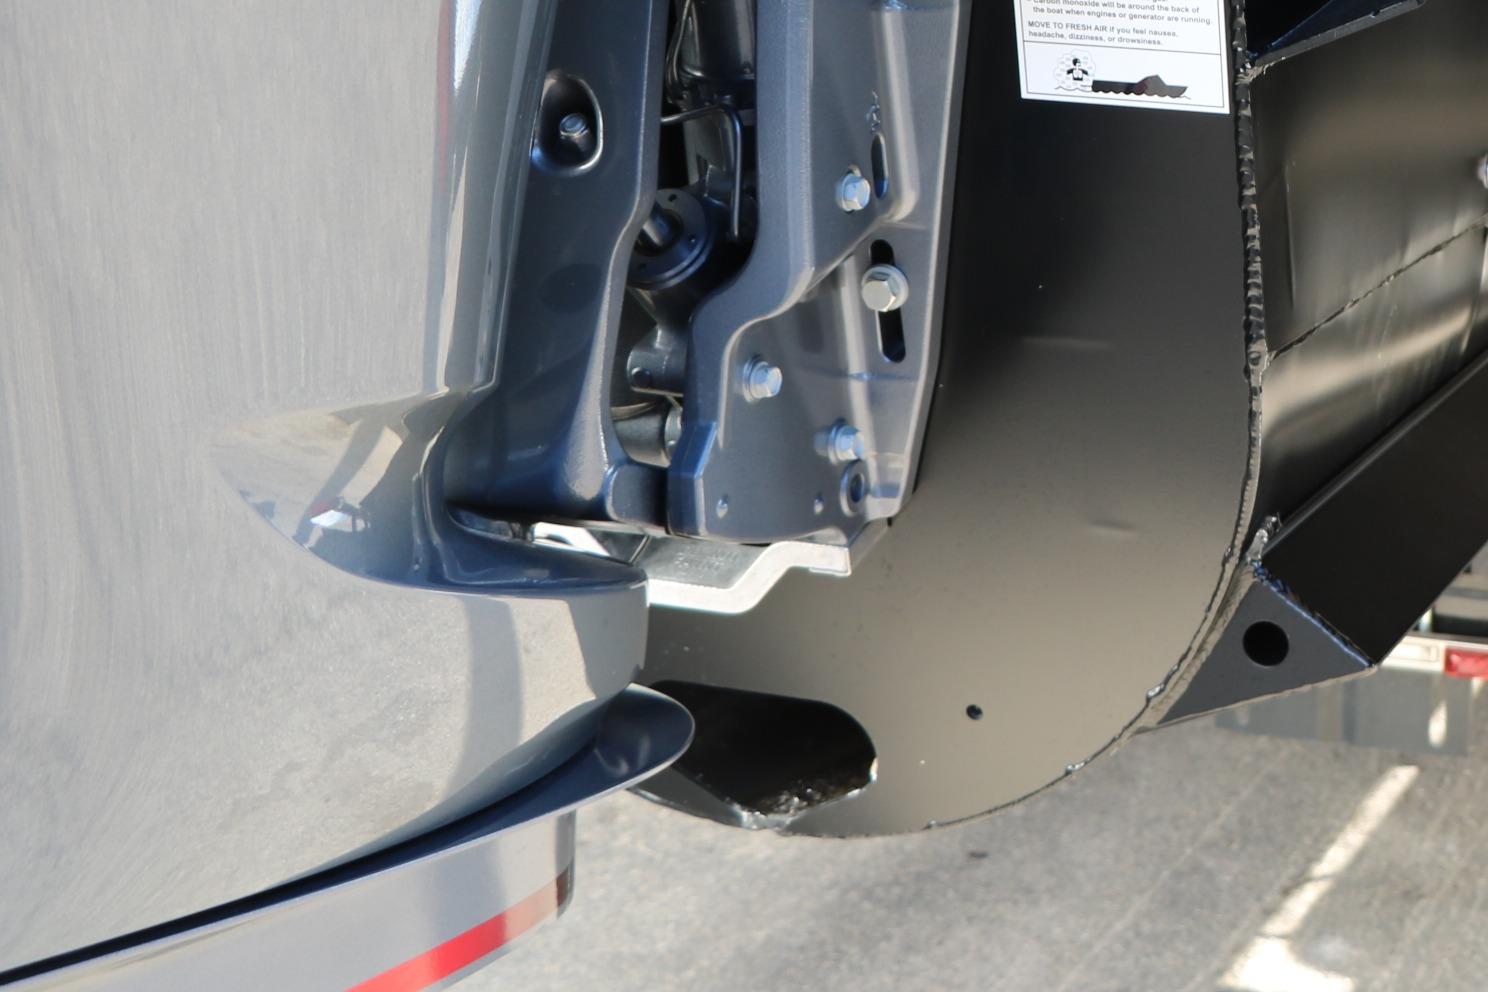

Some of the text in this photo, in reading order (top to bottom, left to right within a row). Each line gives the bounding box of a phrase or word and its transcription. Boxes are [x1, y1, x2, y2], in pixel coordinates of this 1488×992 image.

[1062, 0, 1100, 7] monoxide
[1128, 3, 1155, 11] around
[1171, 5, 1189, 13] back
[1065, 8, 1085, 16] when
[1087, 10, 1116, 18] engines
[1128, 13, 1164, 21] generator
[1028, 20, 1050, 29] MOVE
[1065, 22, 1092, 31] FRESH
[1094, 24, 1107, 32] AIR
[1132, 27, 1146, 35] feel
[1028, 30, 1067, 40] headache,
[1068, 33, 1106, 42] dizziness,
